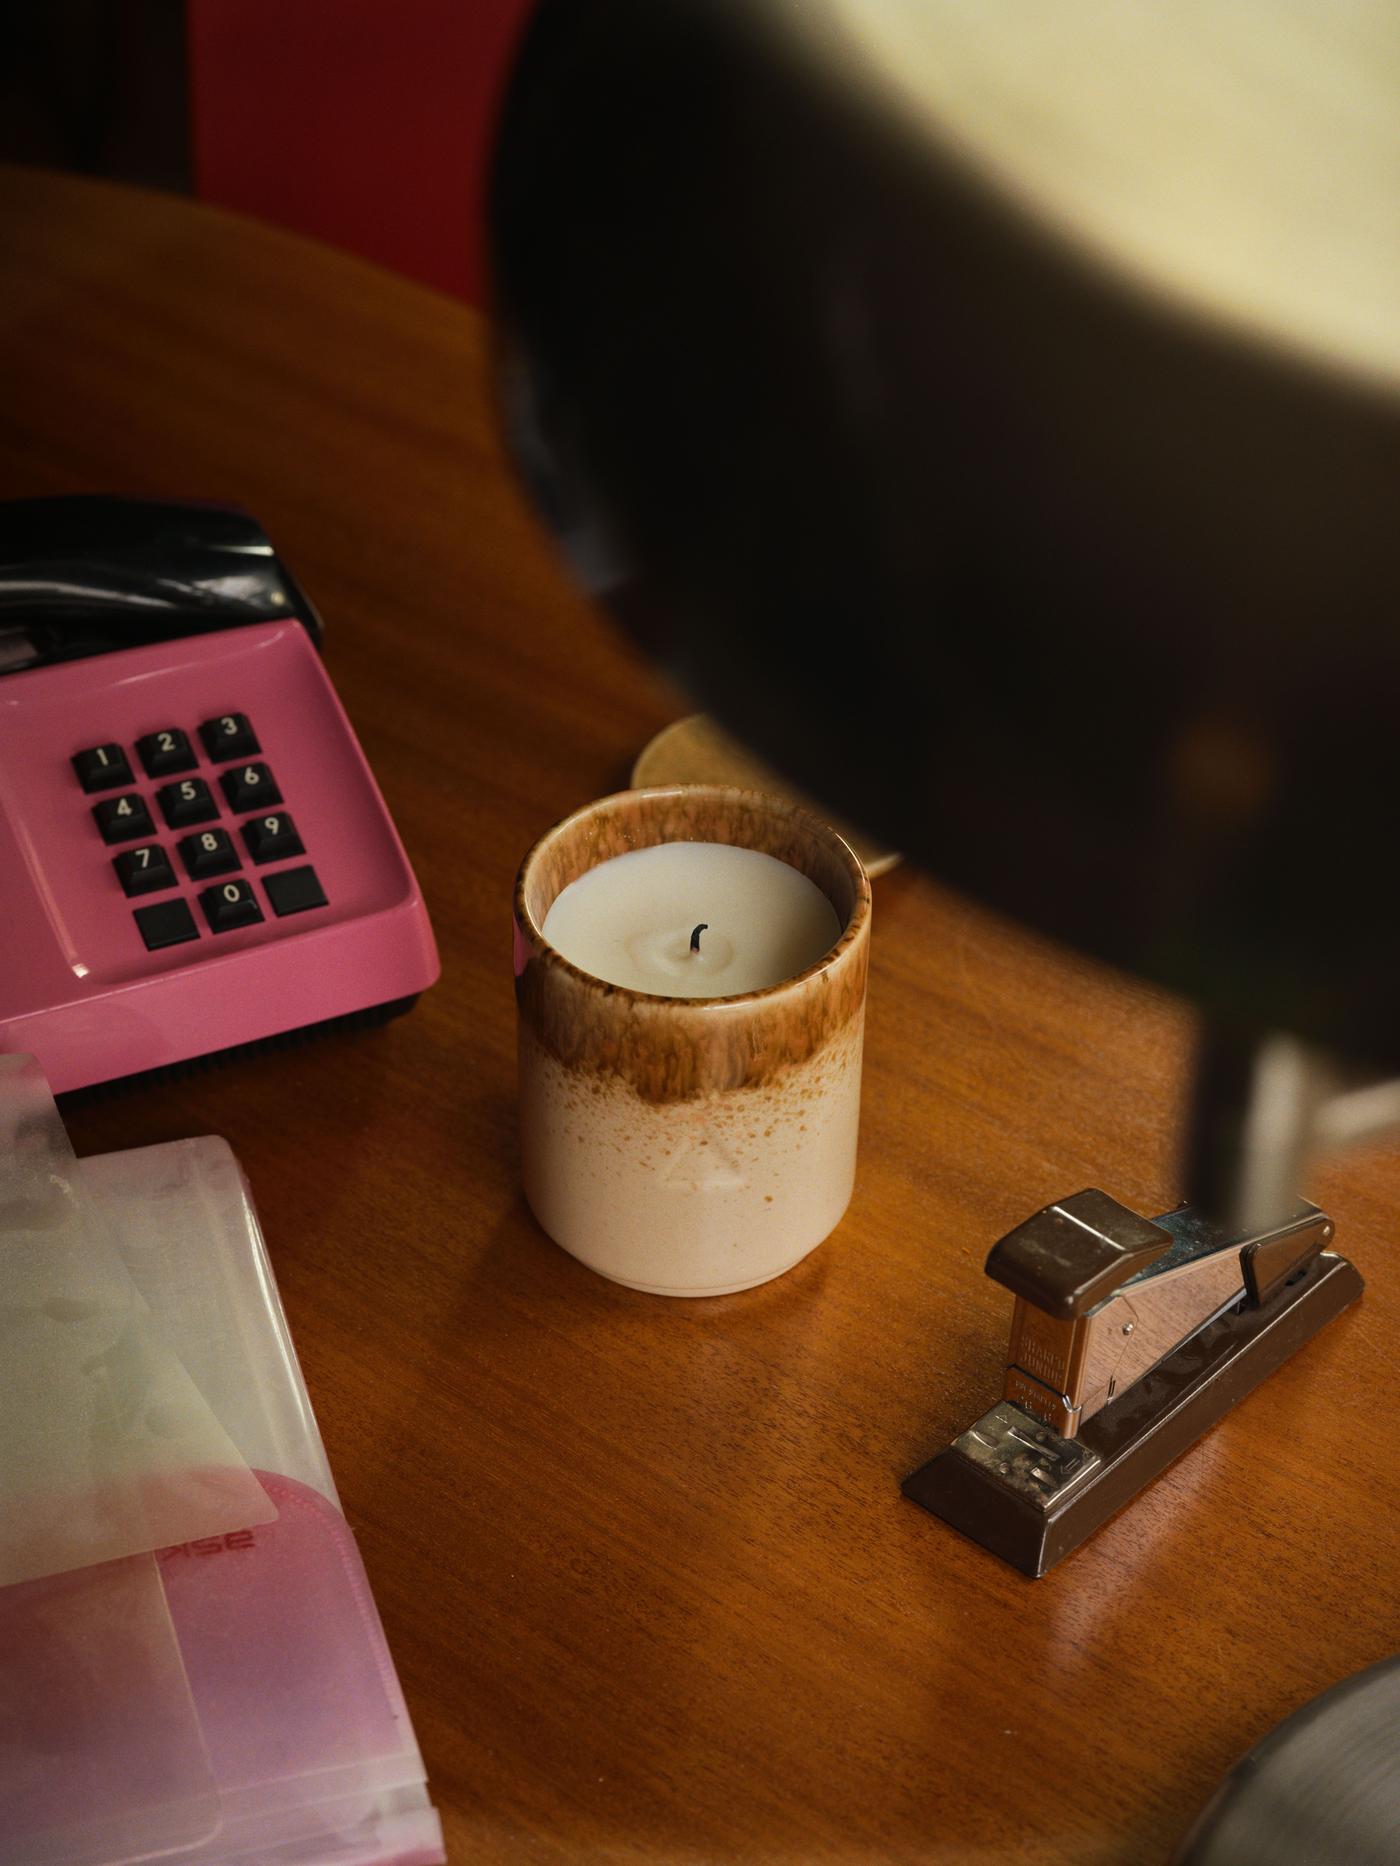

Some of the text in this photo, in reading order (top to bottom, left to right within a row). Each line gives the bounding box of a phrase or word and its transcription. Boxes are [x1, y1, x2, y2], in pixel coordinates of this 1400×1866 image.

[221, 717, 238, 735] 3
[157, 732, 175, 752] 2
[96, 748, 109, 766] 1
[244, 766, 259, 785] 6
[180, 781, 196, 800] 5
[116, 798, 132, 816] 4
[265, 817, 280, 835] 9
[201, 833, 218, 852] 8
[135, 849, 151, 868] 7
[223, 884, 240, 903] 0
